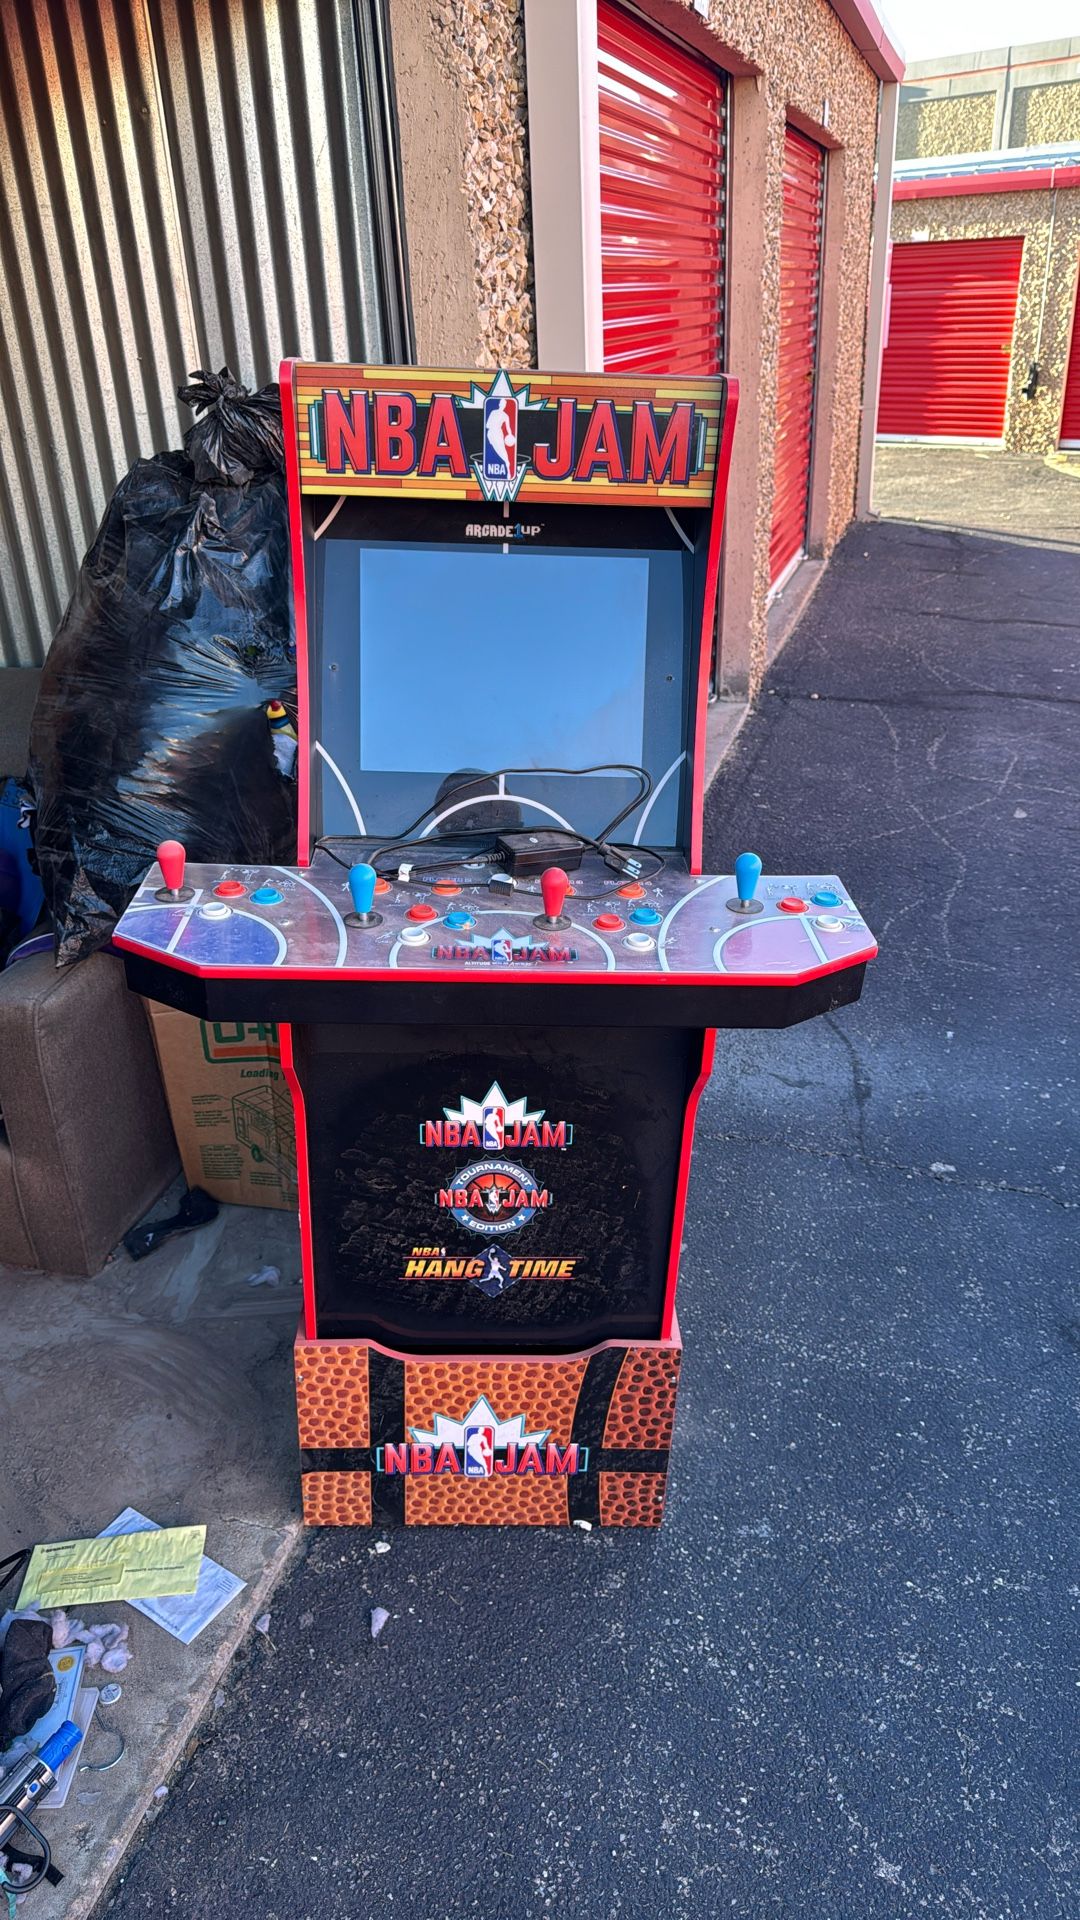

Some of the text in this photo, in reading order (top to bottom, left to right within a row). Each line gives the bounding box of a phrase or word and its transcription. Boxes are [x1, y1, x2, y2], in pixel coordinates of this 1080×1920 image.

[322, 389, 694, 485] NBA JAM
[487, 463, 506, 475] NBA
[436, 944, 572, 961] NBA JAM
[240, 1068, 279, 1081] Loading
[425, 1120, 566, 1148] NBA JAM
[456, 1163, 533, 1187] TOURNAMENT
[438, 1189, 549, 1208] NBA JAM
[468, 1220, 516, 1232] EDITION
[411, 1247, 440, 1257] NBA
[404, 1258, 577, 1278] HANG TIME
[384, 1442, 580, 1476] NBA JAM
[467, 1466, 484, 1475] NBA
